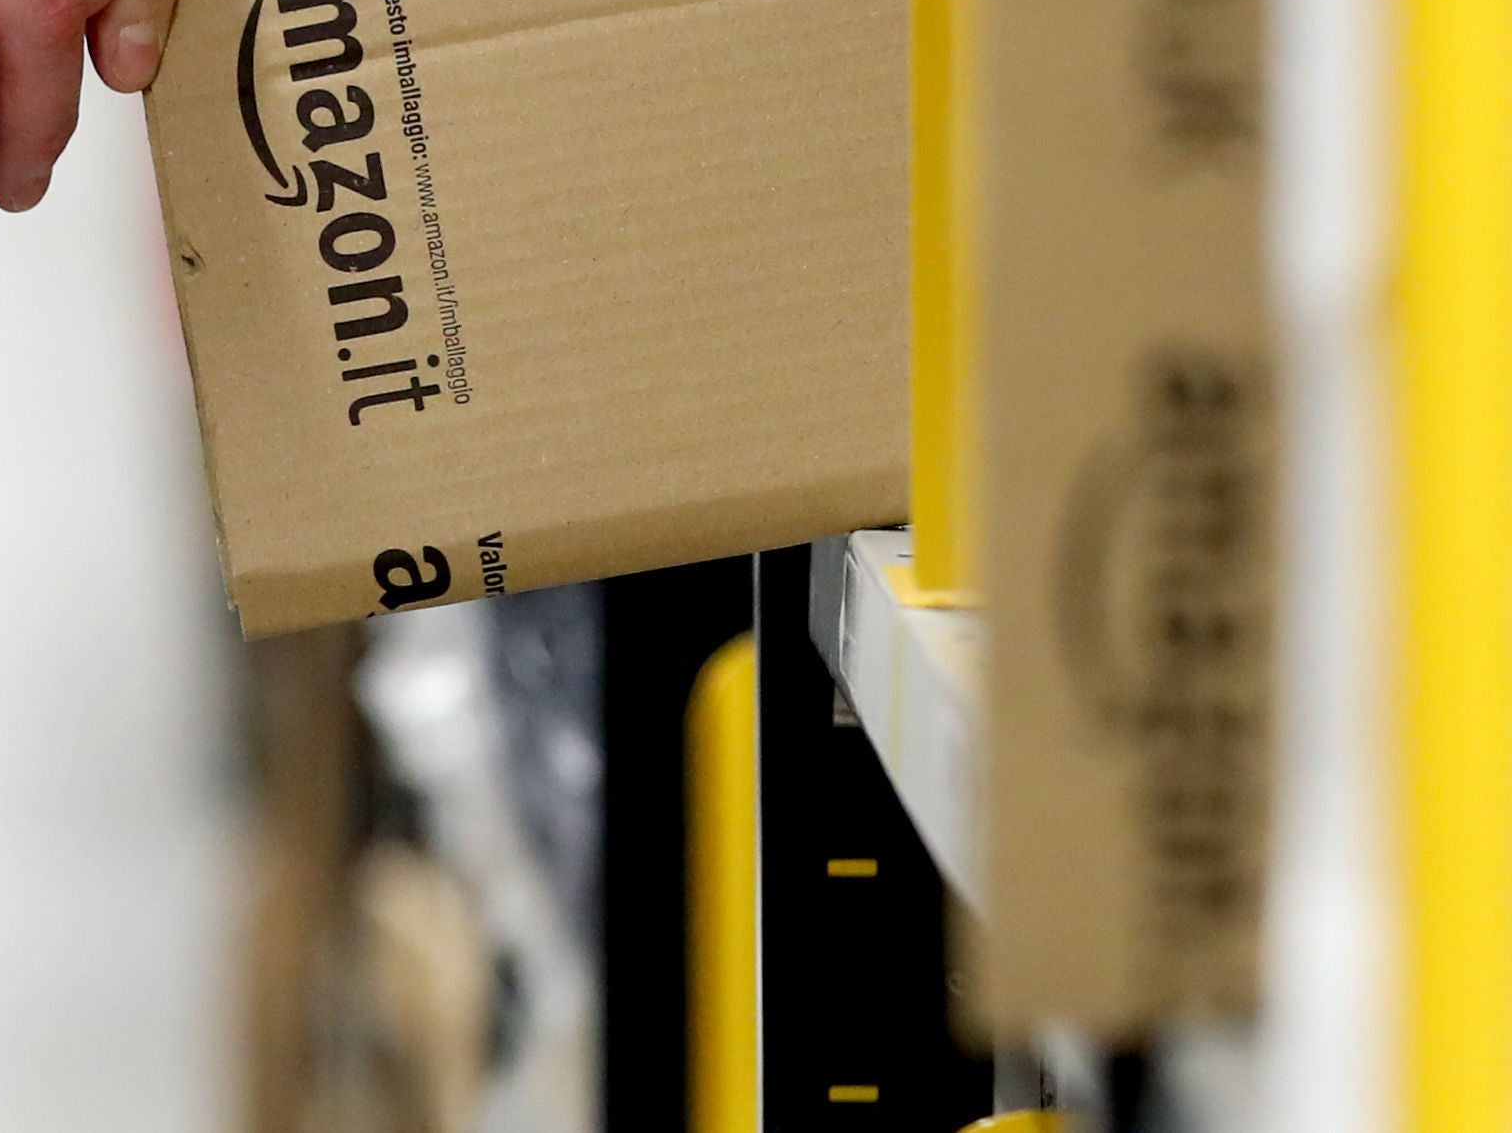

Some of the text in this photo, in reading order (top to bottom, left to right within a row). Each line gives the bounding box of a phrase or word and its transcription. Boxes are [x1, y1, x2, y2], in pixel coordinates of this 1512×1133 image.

[391, 38, 430, 161] imballaggio:
[414, 162, 472, 405] www.amazon.it/imballaggio
[477, 530, 507, 599] Valor
